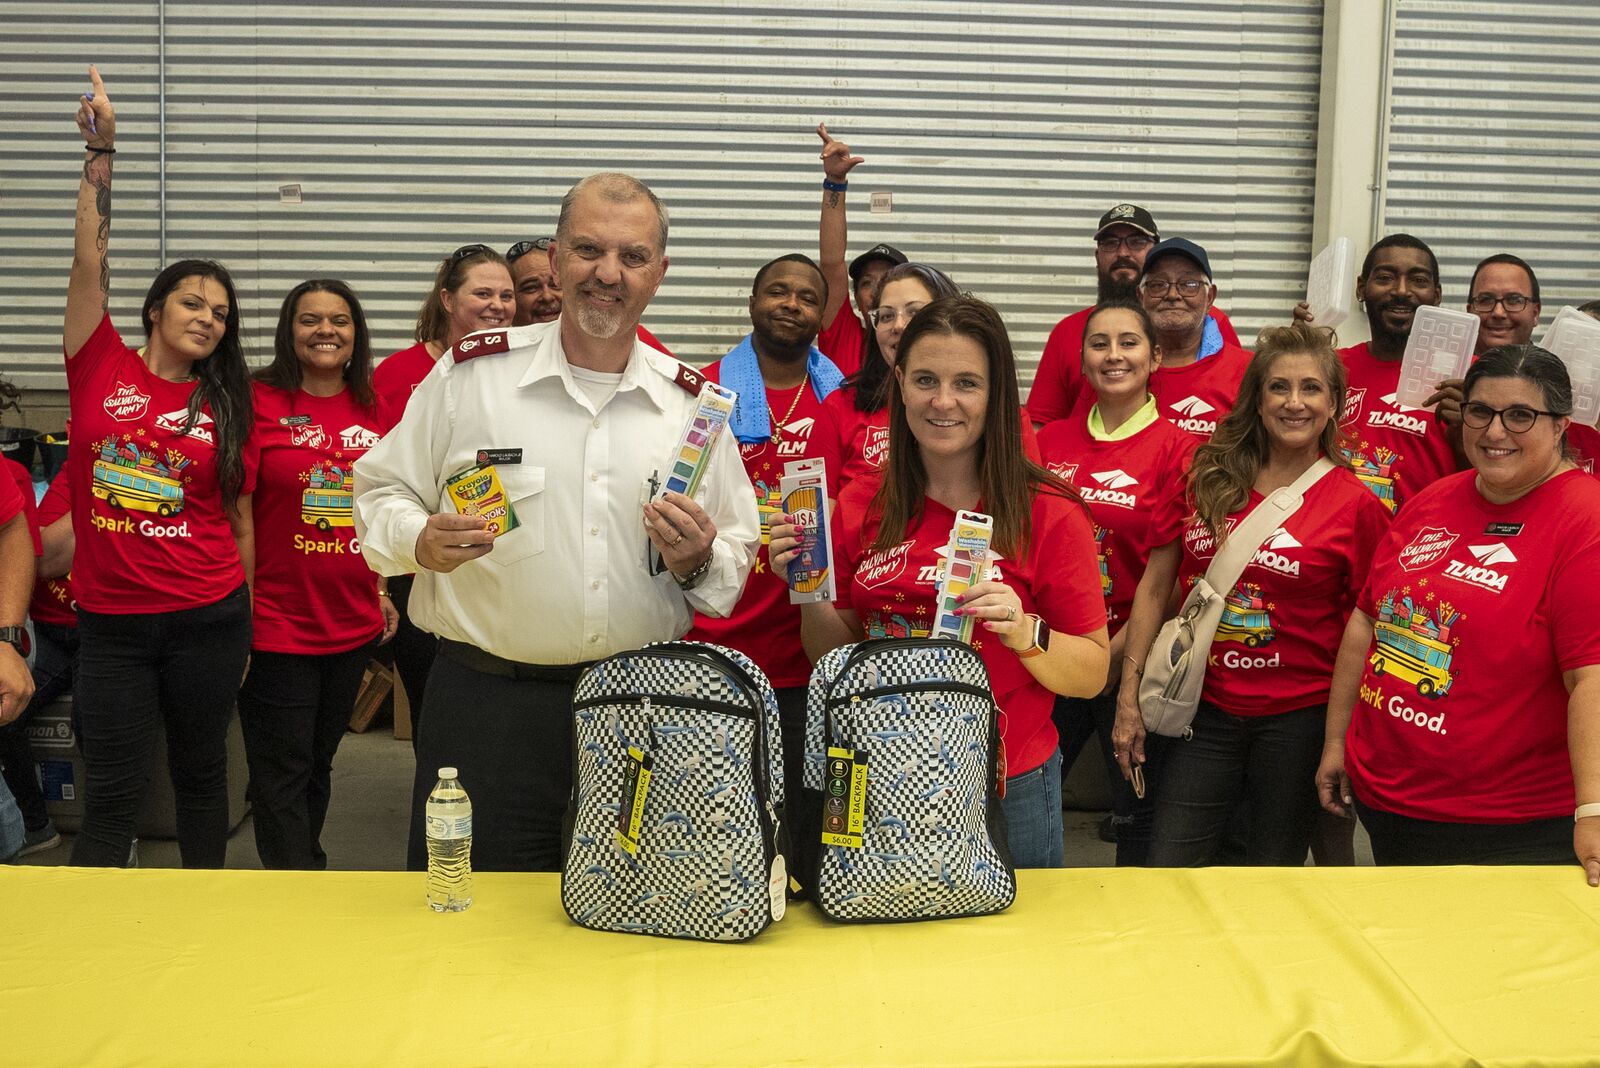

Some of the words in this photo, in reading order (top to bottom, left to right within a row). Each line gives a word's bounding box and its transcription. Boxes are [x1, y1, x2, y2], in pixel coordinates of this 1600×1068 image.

[105, 395, 147, 407] SALVATION
[117, 387, 136, 396] THE
[114, 403, 144, 416] ARMY
[1168, 418, 1217, 433] MODA
[1367, 410, 1427, 435] TLMODA
[341, 436, 381, 448] TLMOD
[457, 473, 490, 493] Crayola
[1080, 486, 1137, 507] TLMODA
[91, 508, 136, 533] Spark
[139, 519, 193, 538] Good.
[489, 523, 499, 532] 24
[793, 512, 815, 526] USA
[293, 533, 346, 555] Spark
[1420, 531, 1443, 543] THE
[1401, 537, 1454, 558] SALVATION
[1249, 549, 1300, 576] MODA
[1405, 550, 1442, 566] ARMY
[863, 557, 901, 583] ARMY
[1444, 559, 1509, 590] TLMODA
[1388, 695, 1447, 735] Good.
[634, 772, 648, 819] BACKPACK
[852, 767, 864, 814] BACKPACK
[832, 836, 852, 845] $6.00
